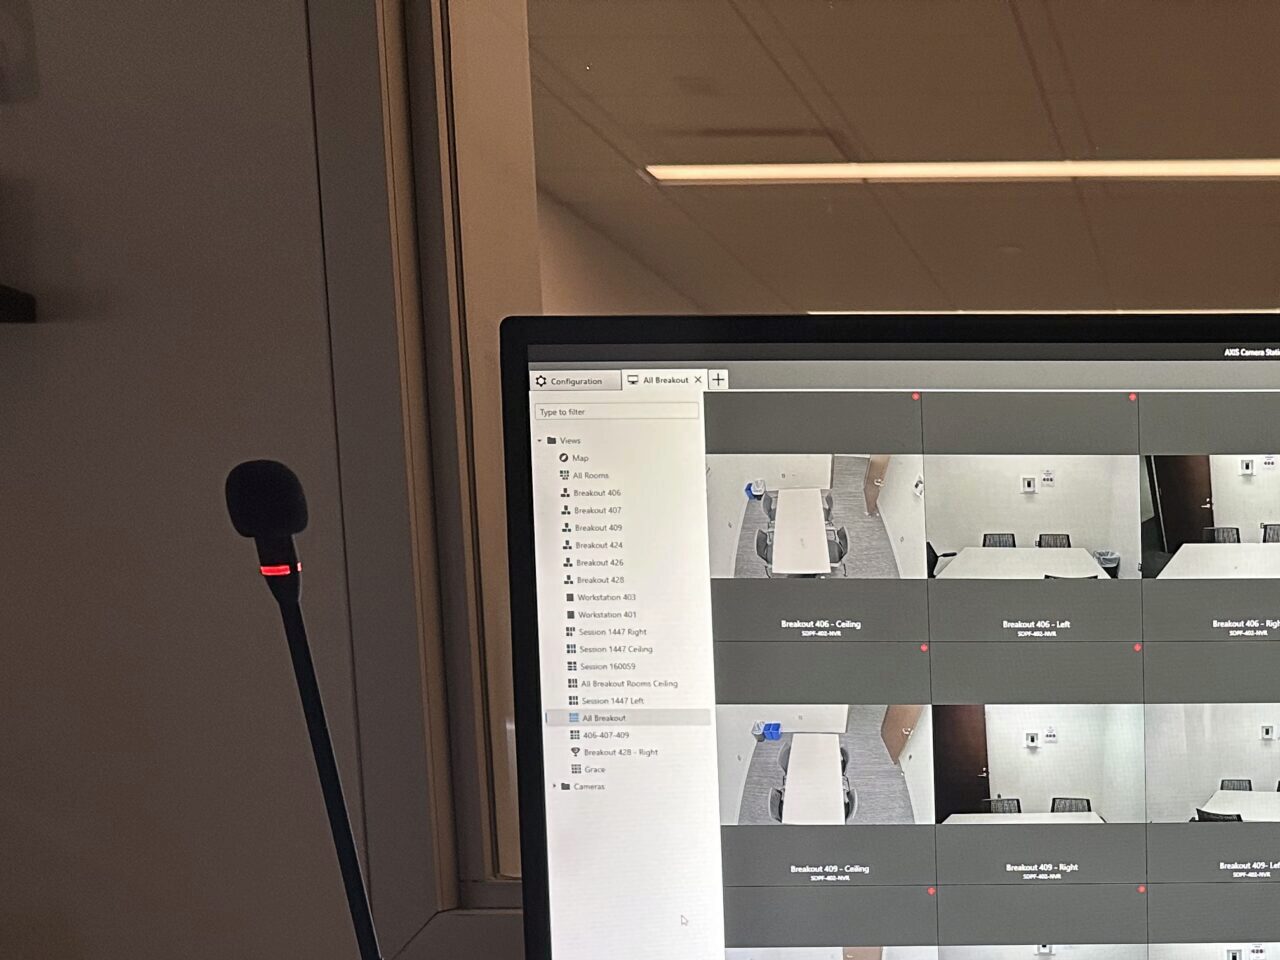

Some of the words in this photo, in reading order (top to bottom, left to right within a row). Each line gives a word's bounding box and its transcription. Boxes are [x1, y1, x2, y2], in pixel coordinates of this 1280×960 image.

[1224, 348, 1239, 356] AXIS
[1240, 348, 1264, 356] Camera
[551, 378, 602, 387] Configuration
[540, 409, 557, 417] Type
[572, 455, 589, 463] Map
[781, 620, 813, 629] Breakout
[815, 620, 829, 628] 406
[836, 620, 861, 629] Ceiling
[1003, 620, 1034, 628] Breakout
[1036, 620, 1050, 628] 406
[1057, 620, 1070, 628] Left
[1213, 620, 1244, 629] Breakout
[1246, 620, 1259, 628] 406
[579, 628, 606, 636] Session
[628, 628, 646, 637] Right
[628, 646, 653, 654] Ceiling
[653, 680, 678, 688] Ceiling
[582, 697, 609, 705] Session
[639, 749, 658, 757] Right
[791, 865, 822, 874] Breakout
[824, 865, 838, 873] 409
[845, 865, 869, 874] Ceiling
[1007, 864, 1037, 872] Breakout
[1059, 864, 1078, 872] Right
